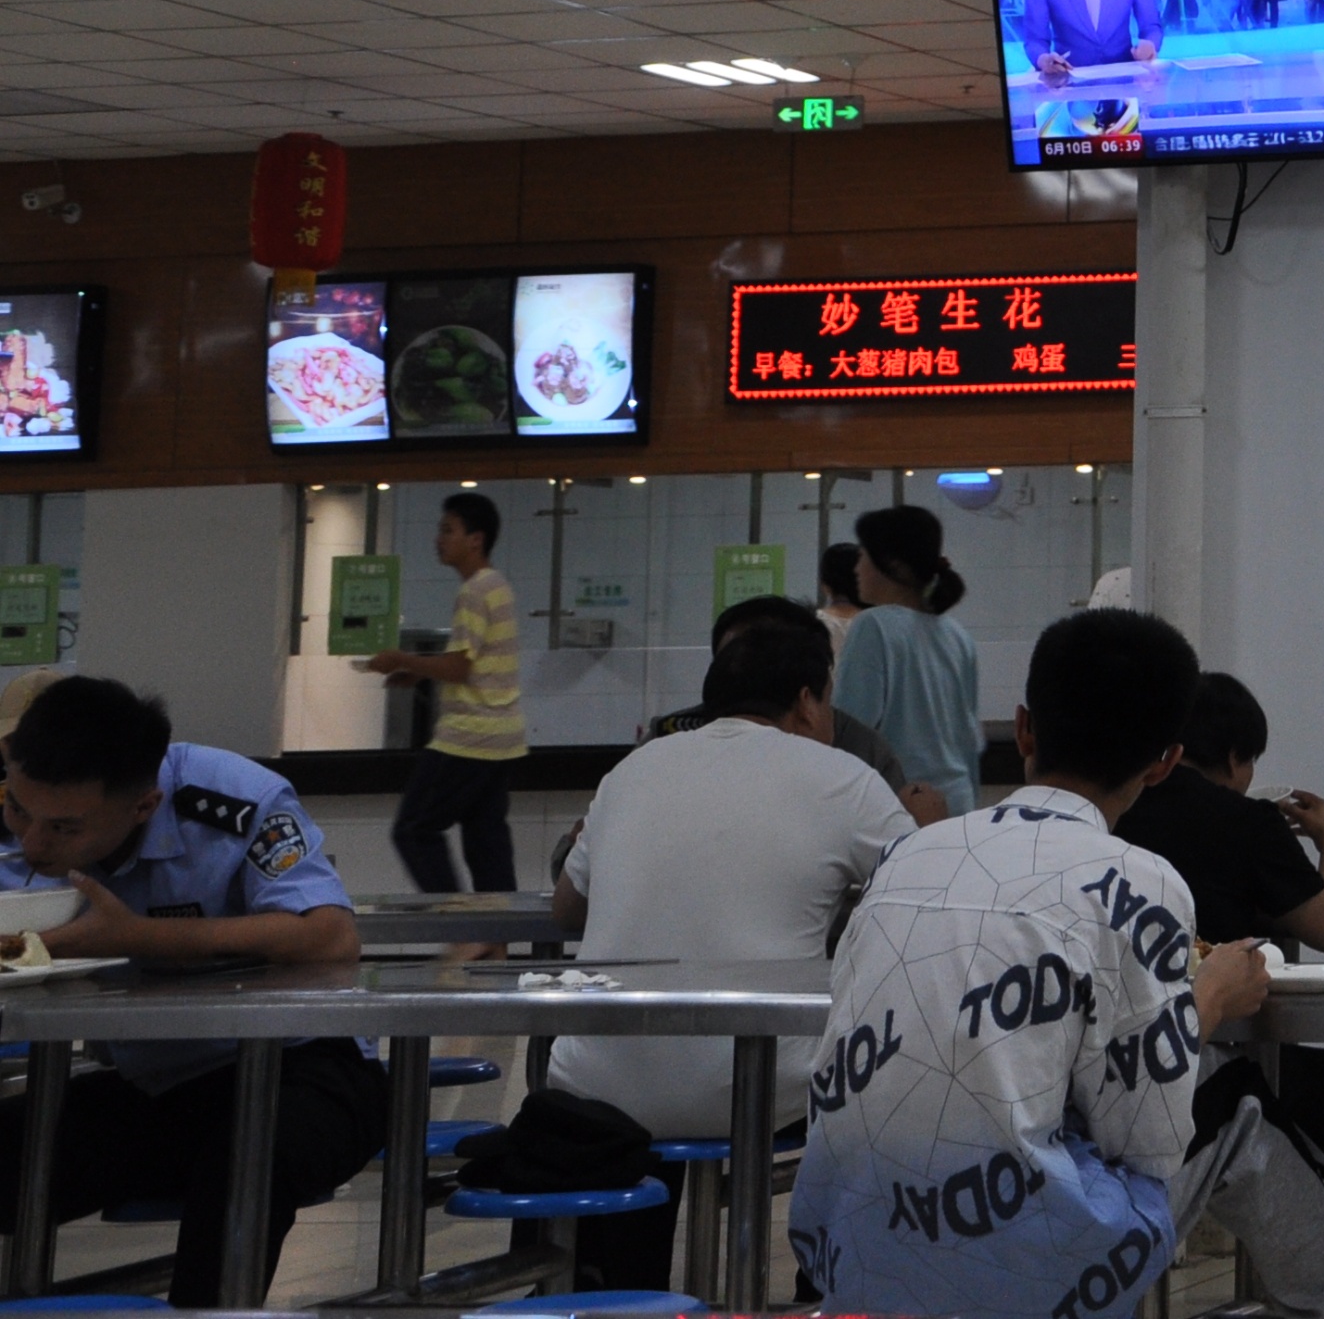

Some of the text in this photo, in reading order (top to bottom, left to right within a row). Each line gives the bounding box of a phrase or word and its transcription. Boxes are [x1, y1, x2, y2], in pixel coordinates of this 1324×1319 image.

[1045, 139, 1141, 156] 6月10日 06:39
[819, 287, 1043, 337] 妙笔生花
[1011, 343, 1065, 373] 鸡蛋
[1080, 867, 1190, 983] ODAY
